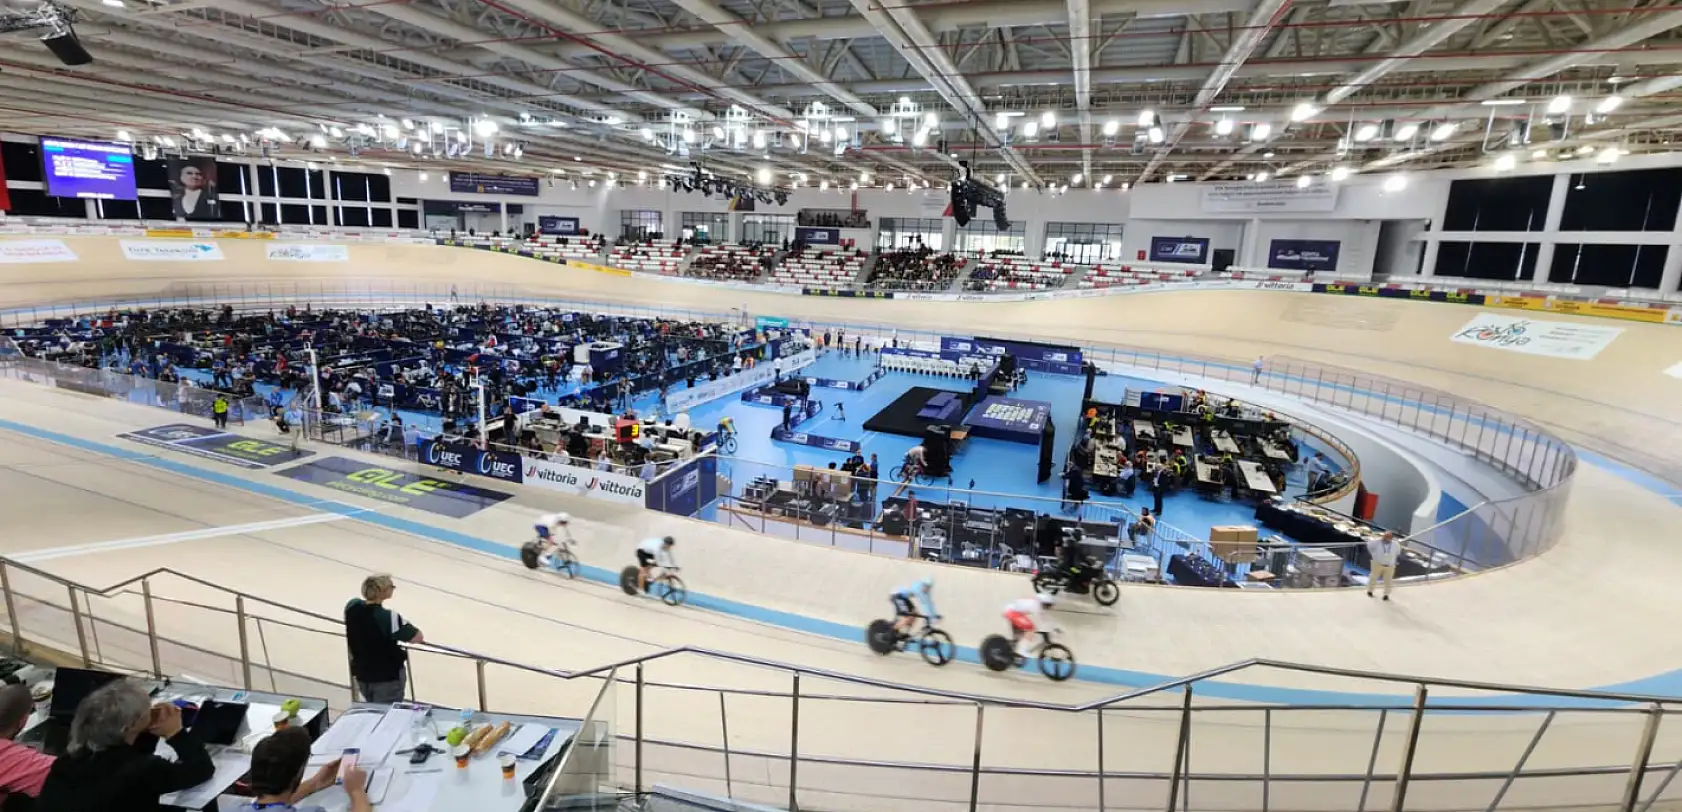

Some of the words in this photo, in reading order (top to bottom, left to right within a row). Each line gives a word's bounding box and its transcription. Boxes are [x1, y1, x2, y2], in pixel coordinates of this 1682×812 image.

[440, 451, 462, 464] UEC
[493, 461, 515, 474] UEC
[537, 469, 577, 485] vittoria
[599, 479, 642, 498] vittoria
